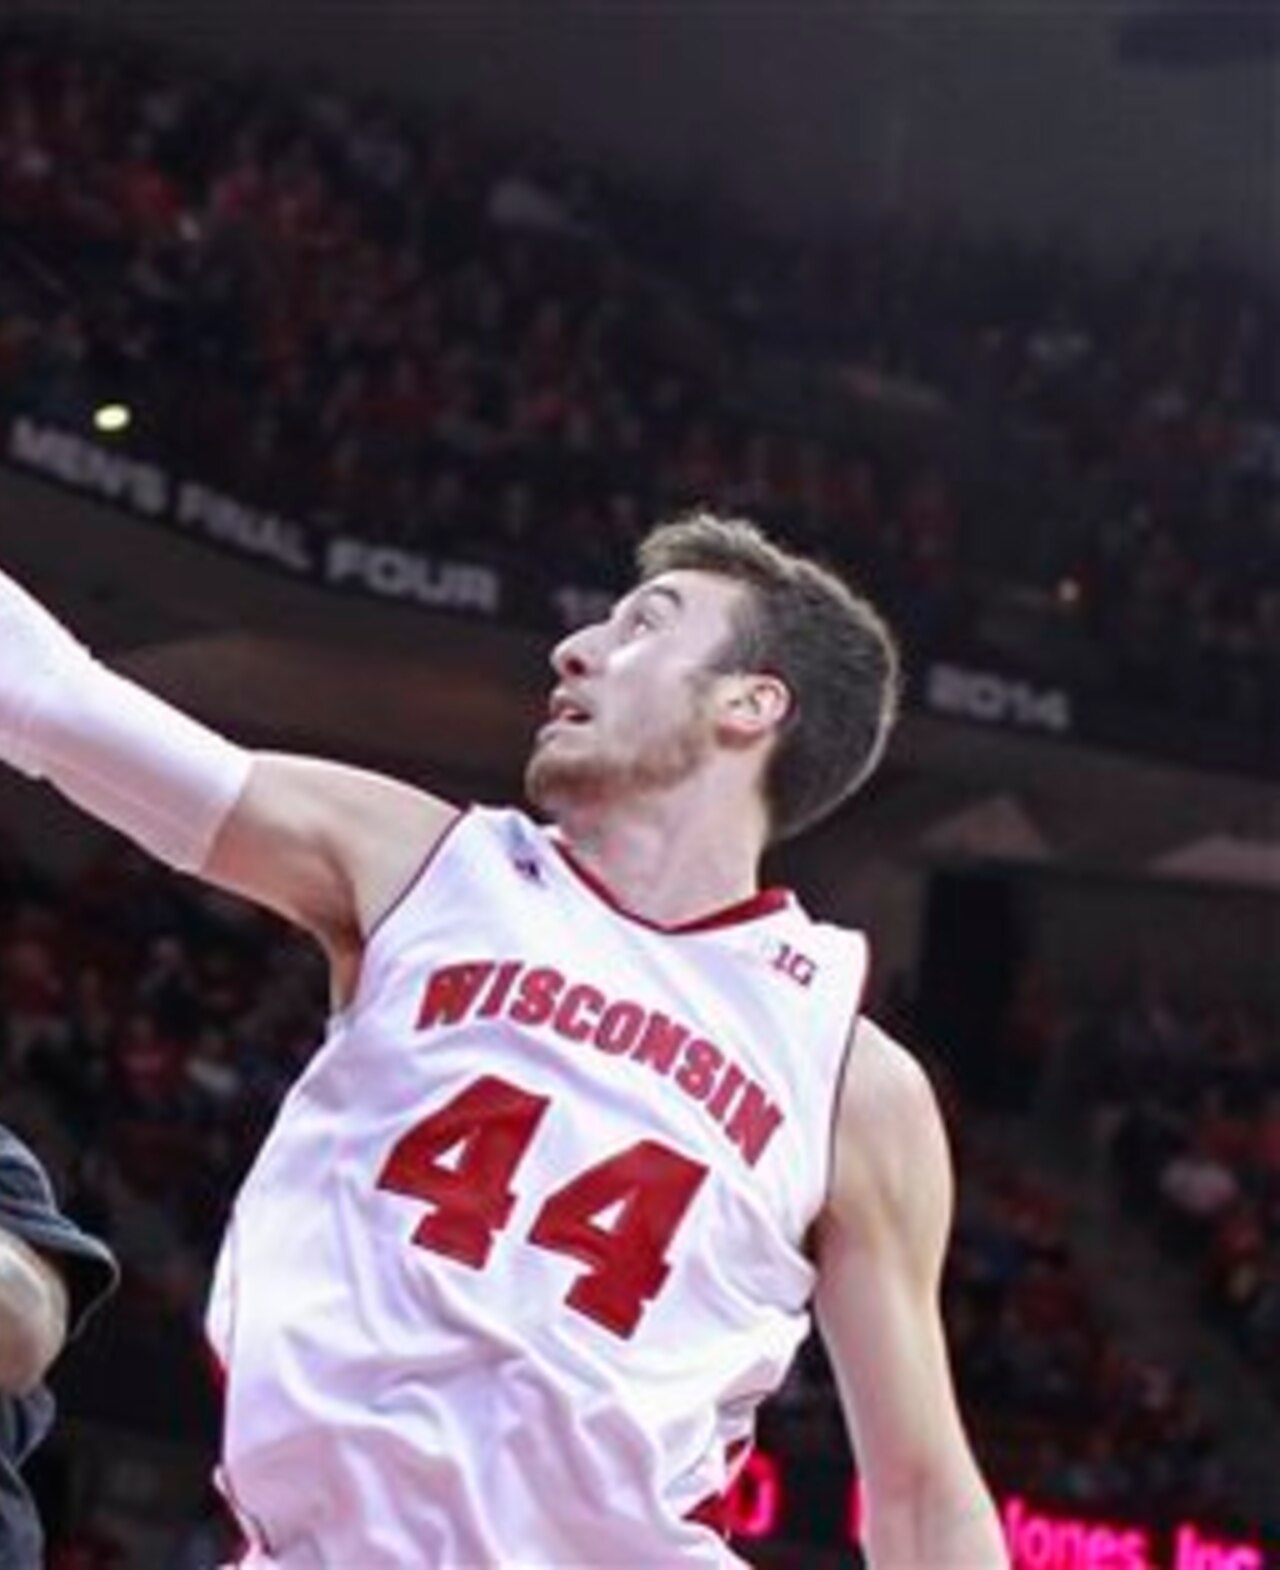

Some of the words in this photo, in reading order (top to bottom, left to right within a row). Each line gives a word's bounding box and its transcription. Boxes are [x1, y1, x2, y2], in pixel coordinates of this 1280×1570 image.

[177, 481, 313, 570] FINAL
[324, 539, 499, 611] FOUR
[928, 663, 1069, 731] 2014
[414, 960, 784, 1168] WISCONSIN
[376, 1074, 710, 1340] 44
